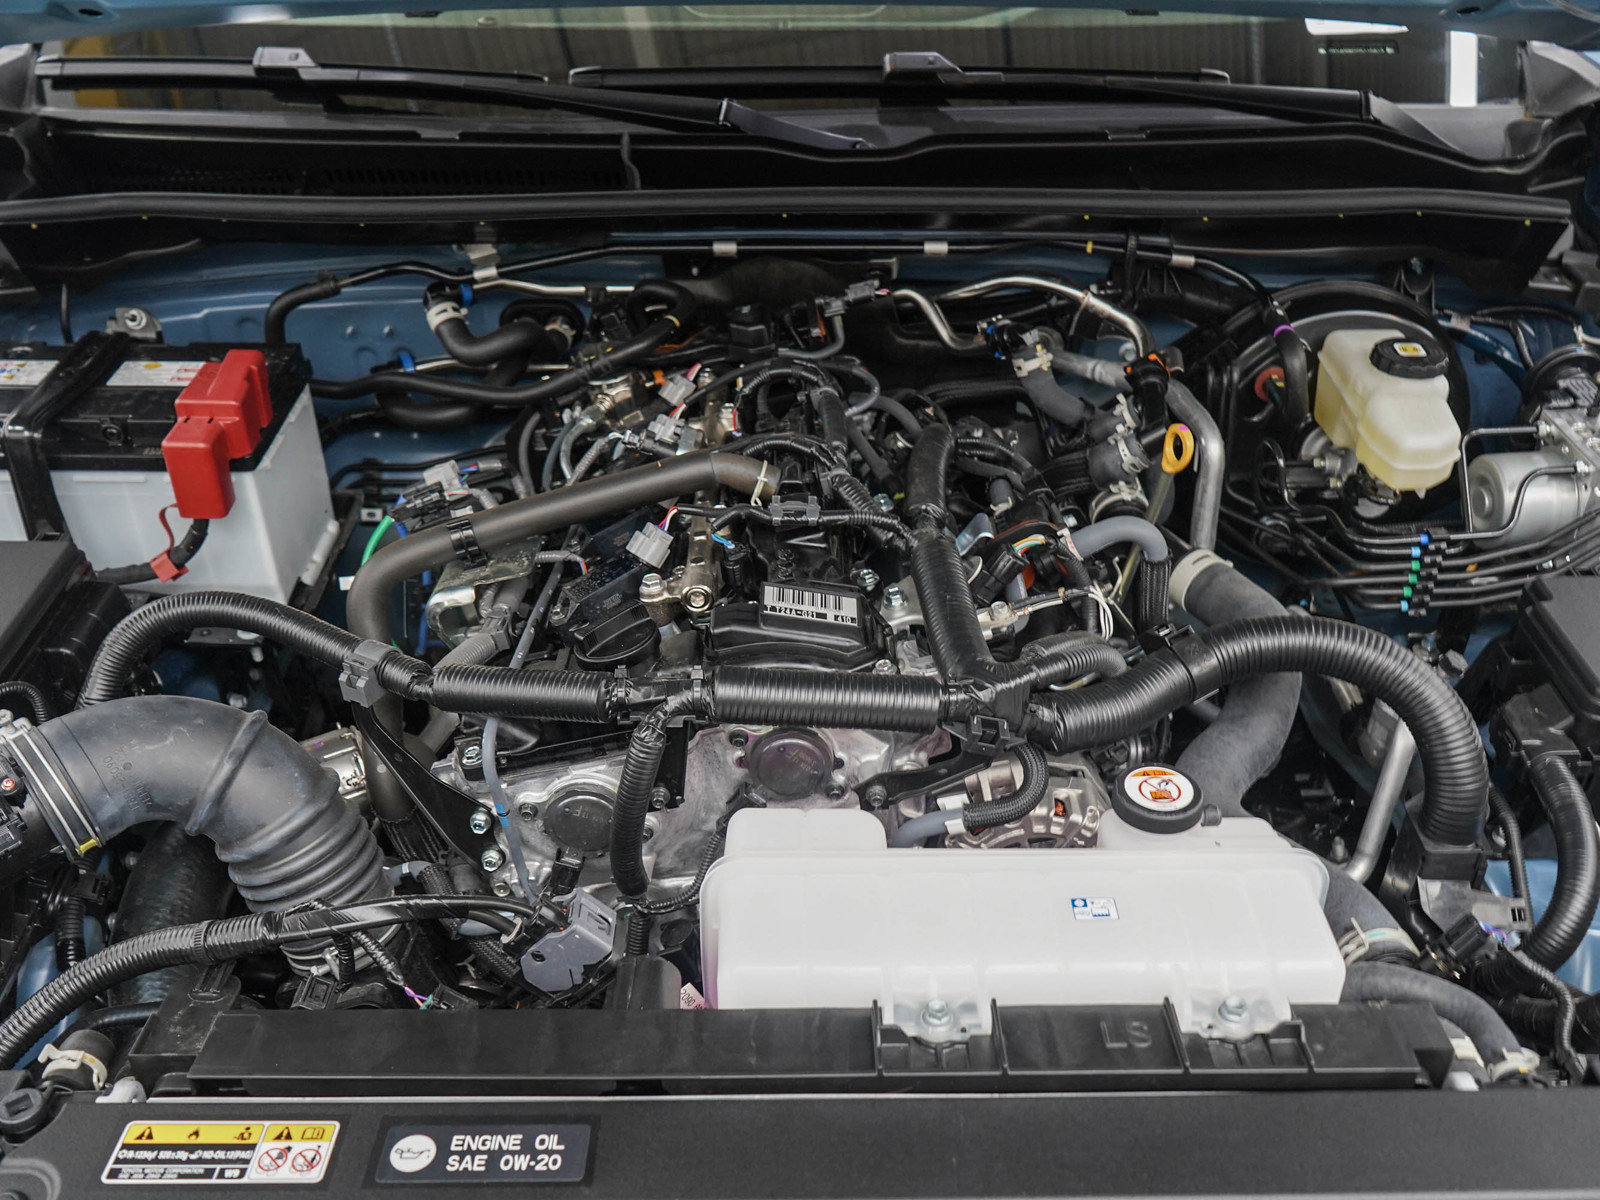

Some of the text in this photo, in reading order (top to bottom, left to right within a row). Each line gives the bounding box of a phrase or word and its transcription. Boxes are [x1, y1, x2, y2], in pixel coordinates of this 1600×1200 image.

[1099, 1021, 1153, 1049] LS
[450, 1133, 566, 1151] ENGINE OIL
[445, 1154, 488, 1172] SAE
